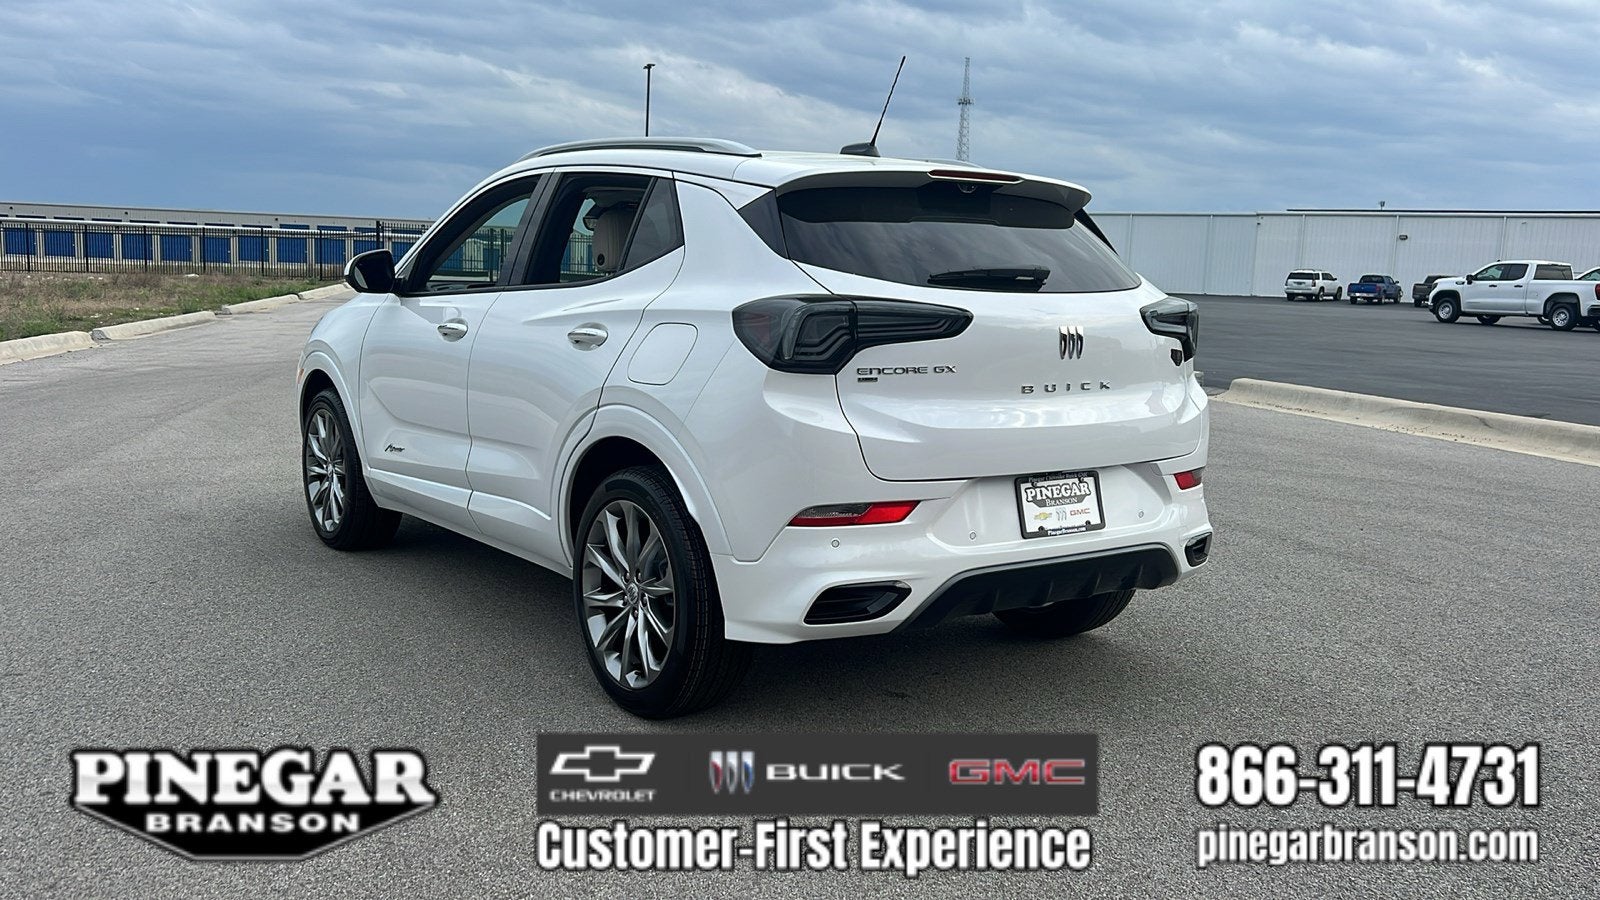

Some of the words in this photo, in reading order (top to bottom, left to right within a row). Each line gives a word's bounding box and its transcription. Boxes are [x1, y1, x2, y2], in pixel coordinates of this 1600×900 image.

[934, 365, 956, 374] GX
[1021, 381, 1110, 394] BUICK
[1026, 482, 1091, 502] PINEGAR
[1069, 508, 1091, 516] GMC
